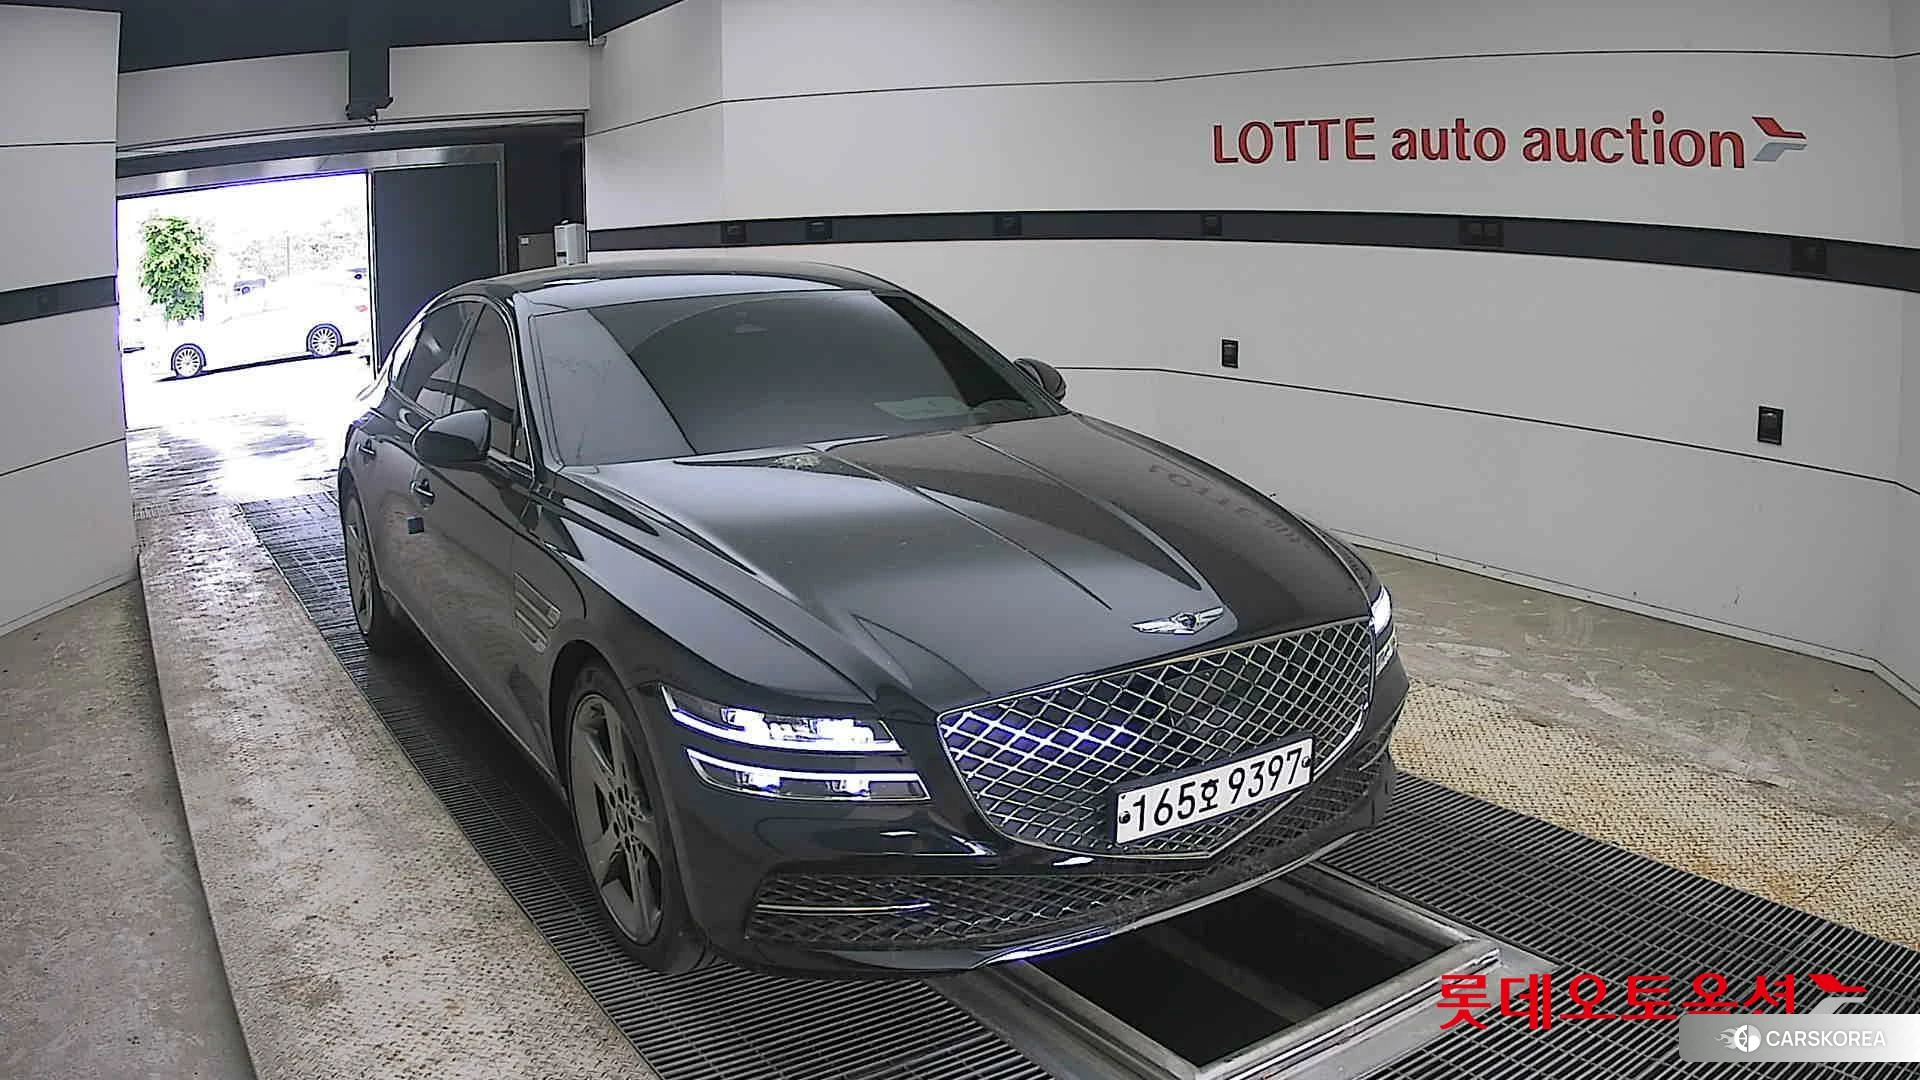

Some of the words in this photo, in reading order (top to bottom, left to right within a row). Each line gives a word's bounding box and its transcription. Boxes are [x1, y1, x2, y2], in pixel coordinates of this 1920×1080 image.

[1212, 116, 1376, 164] LOTTE
[1391, 117, 1507, 162] auto
[1522, 110, 1746, 169] auction
[1228, 747, 1304, 805] 9397
